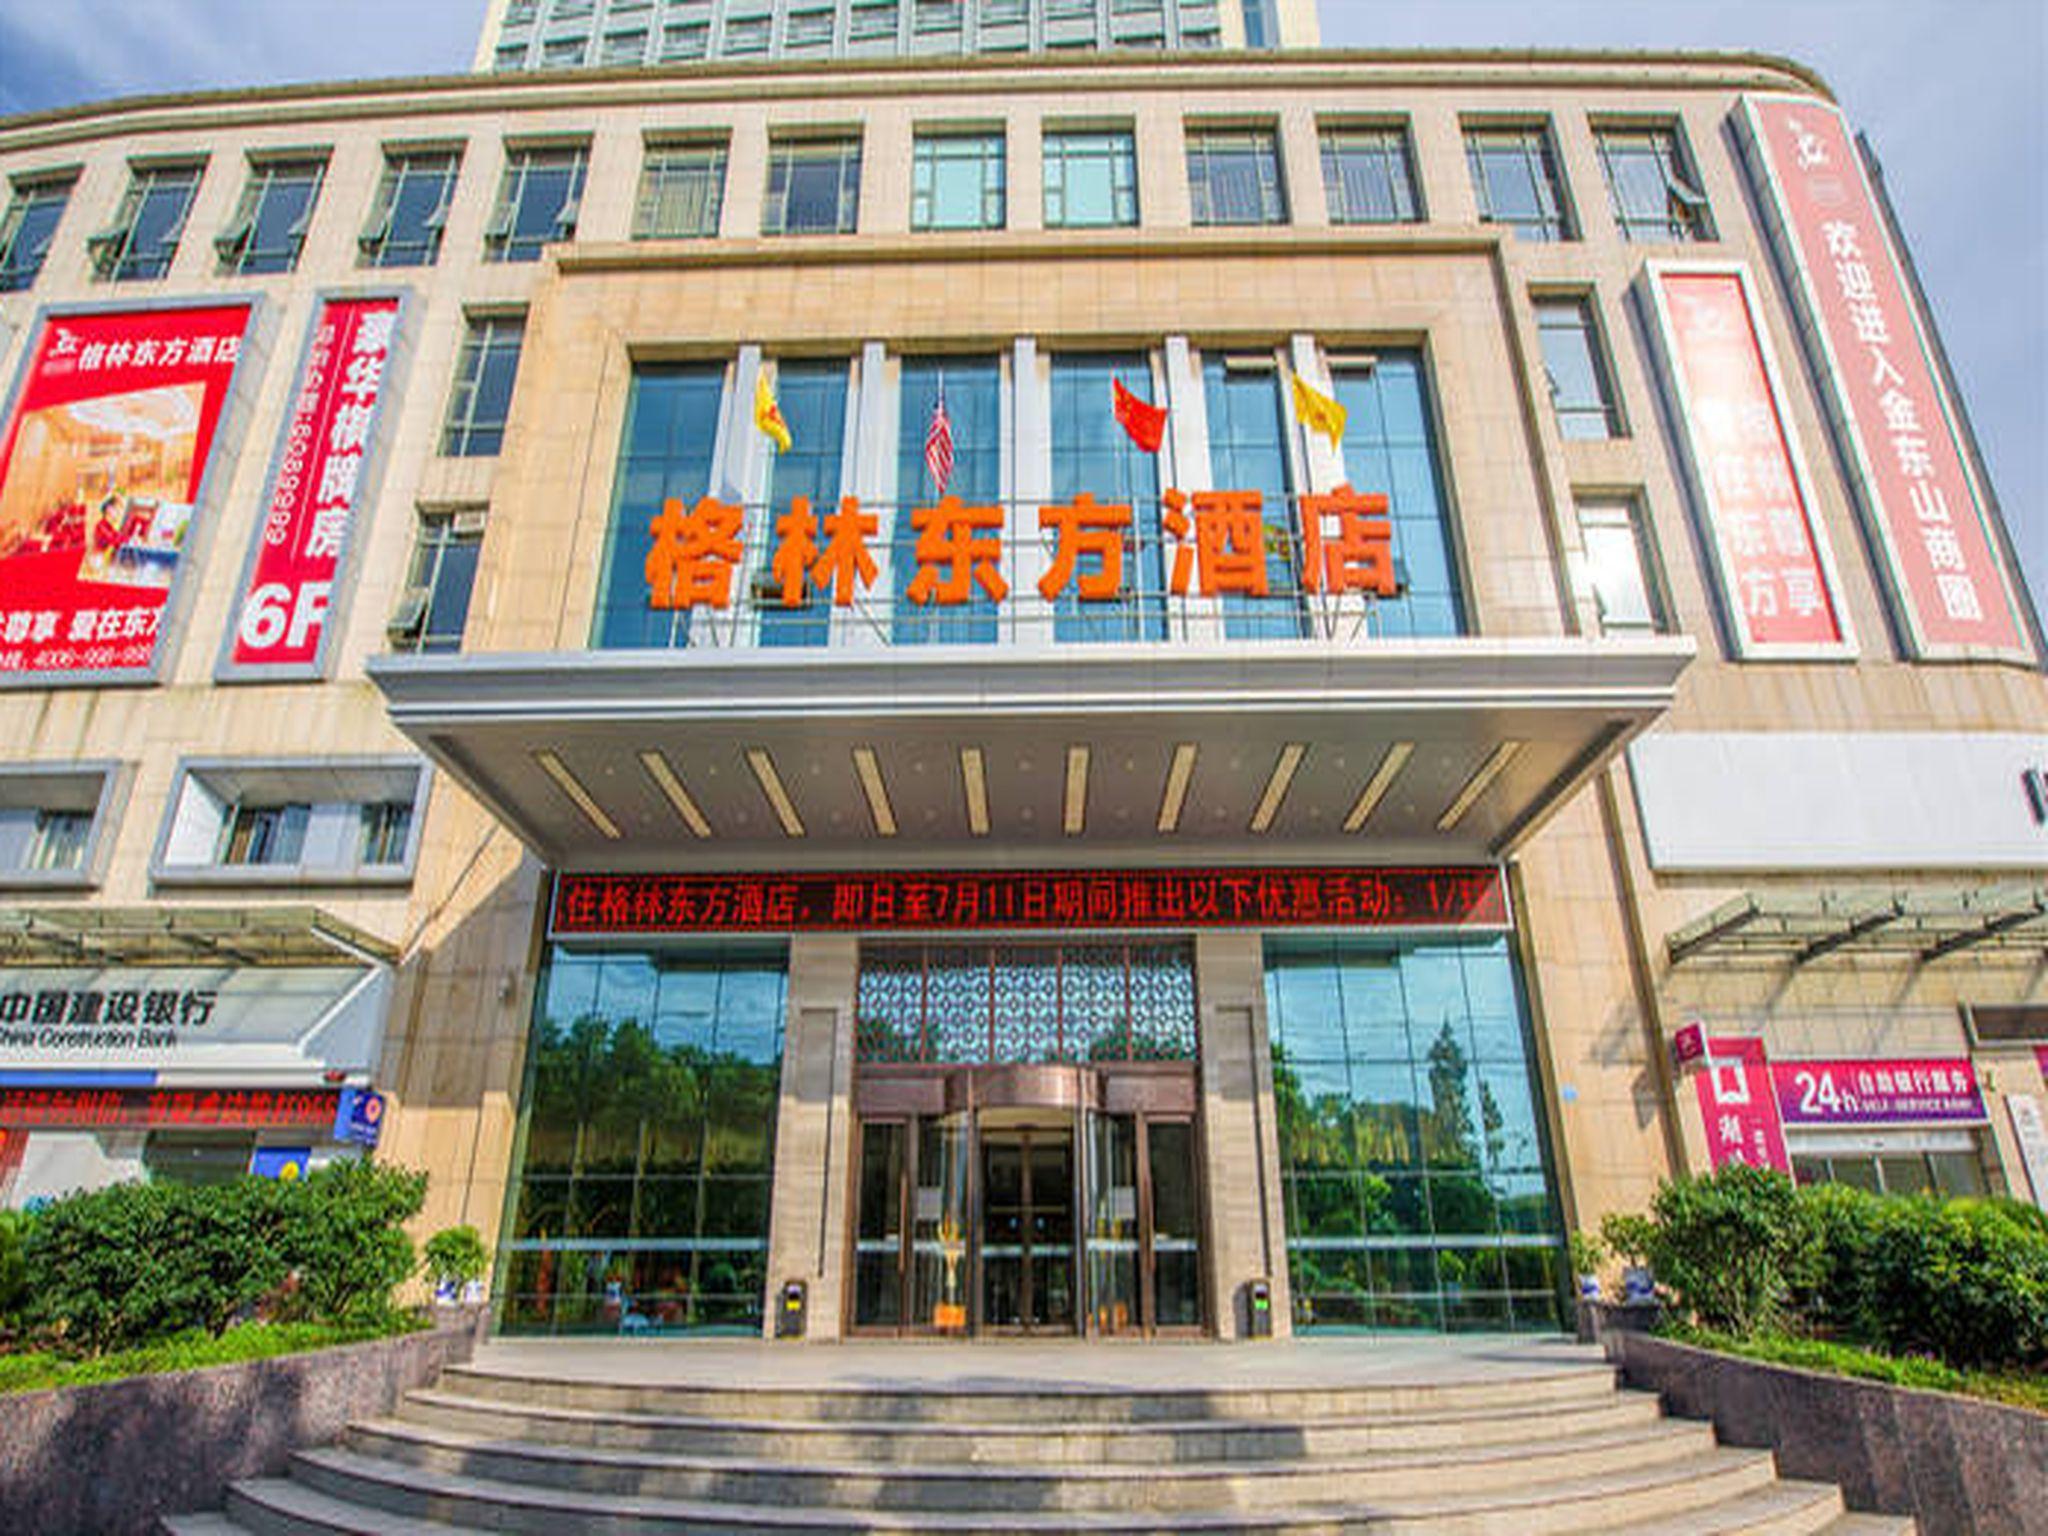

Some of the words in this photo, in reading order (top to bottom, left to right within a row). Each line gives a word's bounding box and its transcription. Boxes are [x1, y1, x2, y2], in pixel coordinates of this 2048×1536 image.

[1820, 219, 1984, 622] 欢迎进入金东山商圈
[643, 485, 1401, 609] 格林东方酒店
[240, 581, 333, 649] 6F
[0, 990, 217, 1025] 中国建设银行
[137, 1028, 178, 1048] Bank
